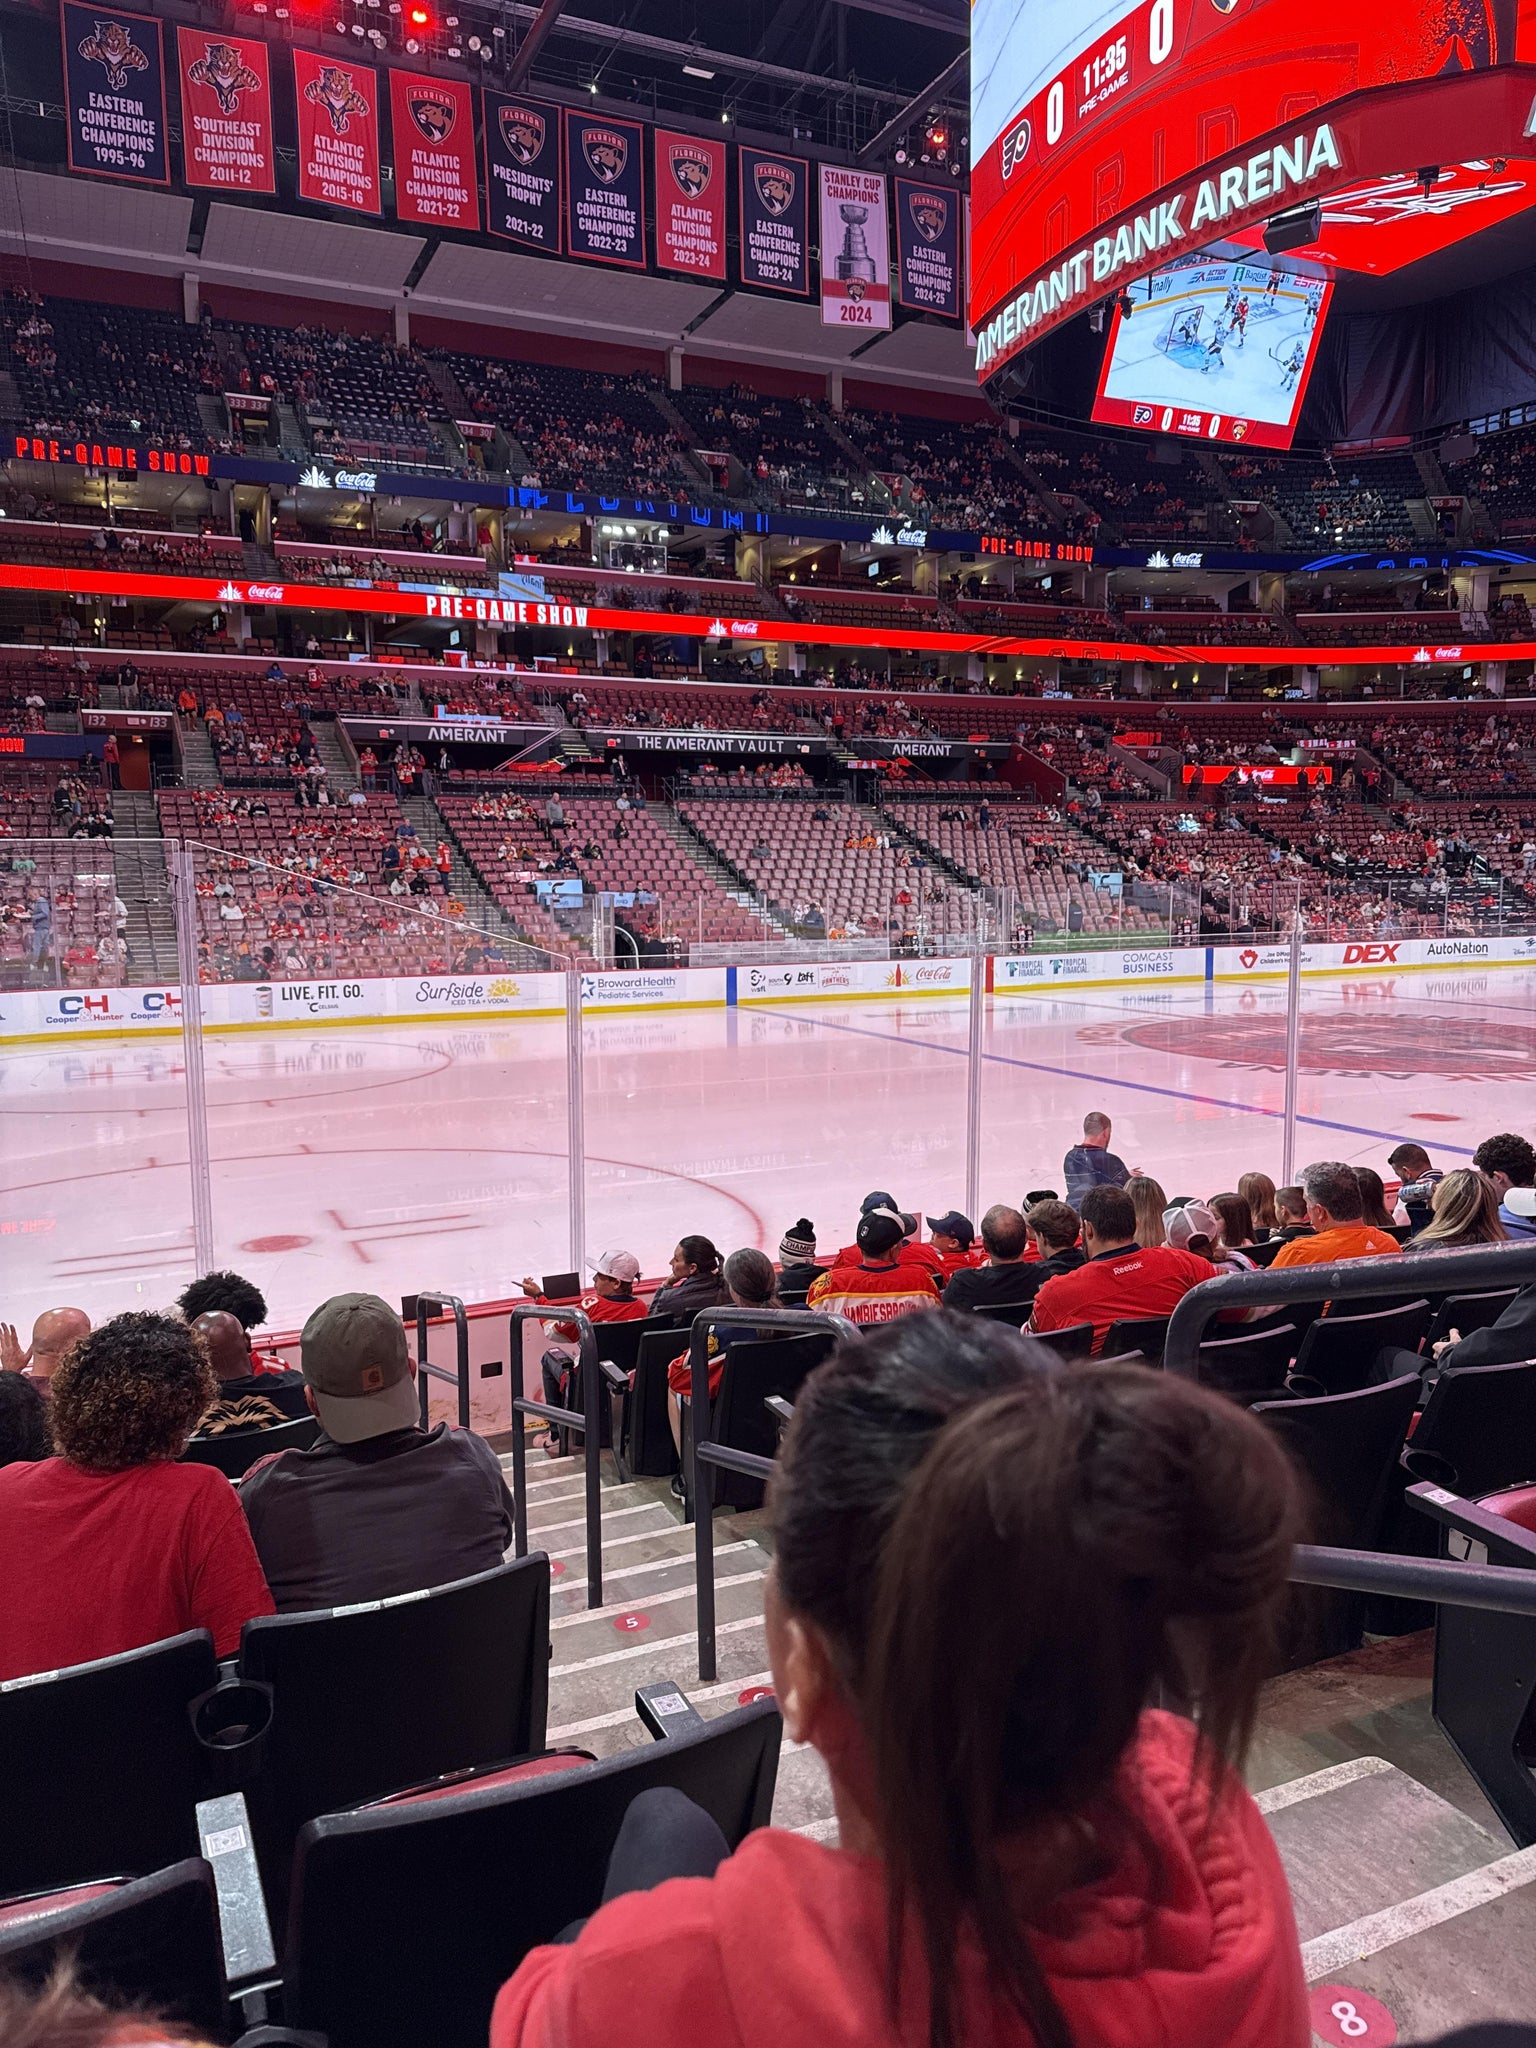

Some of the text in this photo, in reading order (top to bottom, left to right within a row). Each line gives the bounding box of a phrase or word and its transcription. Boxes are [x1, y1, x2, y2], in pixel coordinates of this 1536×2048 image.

[1083, 35, 1126, 96] 11:35
[89, 92, 143, 116] EASTERN
[413, 90, 451, 105] FLORIDA
[1079, 71, 1128, 118] PRE-GAME
[78, 108, 155, 135] CONFERENCE
[504, 111, 540, 127] FLORIDA
[1046, 81, 1063, 145] 0
[193, 116, 261, 137] SOUTHEAST
[81, 126, 154, 152] CHAMPIONS
[202, 133, 254, 151] DIVISION
[313, 134, 364, 159] ATLANTIC
[587, 133, 623, 148] FLORIDA
[93, 146, 145, 168] 1995-96
[194, 148, 264, 168] CHAMPIONS
[315, 149, 362, 173] DIVISION
[411, 149, 460, 169] ATLANTIC
[674, 149, 707, 163] FLORIDA
[209, 166, 251, 184] 2011-12
[307, 162, 371, 189] CHAMPIONS
[413, 165, 460, 186] DIVISION
[493, 163, 553, 193] PRESIDENTS'
[759, 167, 790, 181] FLORIDA
[824, 171, 881, 191] STANLEY CUP
[322, 182, 363, 204] 2015-16
[406, 180, 468, 203] CHAMPIONS
[505, 183, 542, 207] TROPHY
[585, 188, 627, 208] EASTERN
[827, 185, 880, 205] CHAMPIONS
[416, 199, 460, 218] 2021-22
[913, 196, 943, 209] FLORIDA
[576, 202, 636, 225] CONFERENCE
[671, 204, 713, 223] ATLANTIC
[505, 215, 543, 239] 2021-22
[579, 217, 635, 239] CHAMPIONS
[672, 218, 711, 238] DIVISION
[756, 220, 793, 239] EASTERN
[587, 233, 627, 252] 2022-23
[665, 232, 717, 254] CHAMPIONS
[749, 233, 801, 255] CONFERENCE
[975, 123, 1341, 371] AMERANT BANK ARENA
[673, 249, 710, 268] 2023-24
[750, 248, 799, 269] CHAMPIONS
[913, 245, 946, 264] EASTERN
[757, 264, 793, 282] 2023-24
[906, 257, 953, 279] CONFERENCE
[1244, 269, 1268, 282] Baptist
[908, 271, 951, 293] CHAMPIONS
[1152, 276, 1174, 295] inally
[914, 286, 946, 305] 2024-25
[840, 304, 873, 323] 2024
[229, 398, 267, 411] 333 334
[1160, 407, 1174, 431] 0
[1183, 413, 1201, 427] 11:35
[1208, 415, 1221, 438] 0
[16, 437, 209, 476] PRE-GAME SHOW
[981, 536, 1094, 562] PRE-GAME SHOW
[426, 595, 588, 627] PRE-GAME SHOW
[88, 714, 168, 728] 132 133
[428, 727, 507, 743] AMERANT
[637, 736, 784, 753] THE AMERANT VAULT
[892, 743, 952, 756] AMERANT
[1122, 952, 1174, 963] COMCAST
[1342, 943, 1401, 964] DEX
[1427, 942, 1488, 955] AutoNation
[1018, 960, 1043, 968] TROPICAL
[1062, 958, 1087, 966] TROPICAL
[1123, 962, 1174, 974] BUSINESS
[415, 981, 484, 1002] Surfside
[598, 976, 675, 988] Broward Health
[282, 984, 364, 1001] LIVE. FIT. GO.
[598, 990, 664, 1000] Pediatric Services
[45, 1016, 79, 1025] Cooper
[93, 1014, 124, 1022] Hunter
[1113, 1260, 1143, 1276] Reebok
[1462, 1535, 1473, 1561] 7
[625, 1617, 639, 1629] 5
[1330, 2001, 1369, 2036] 8
